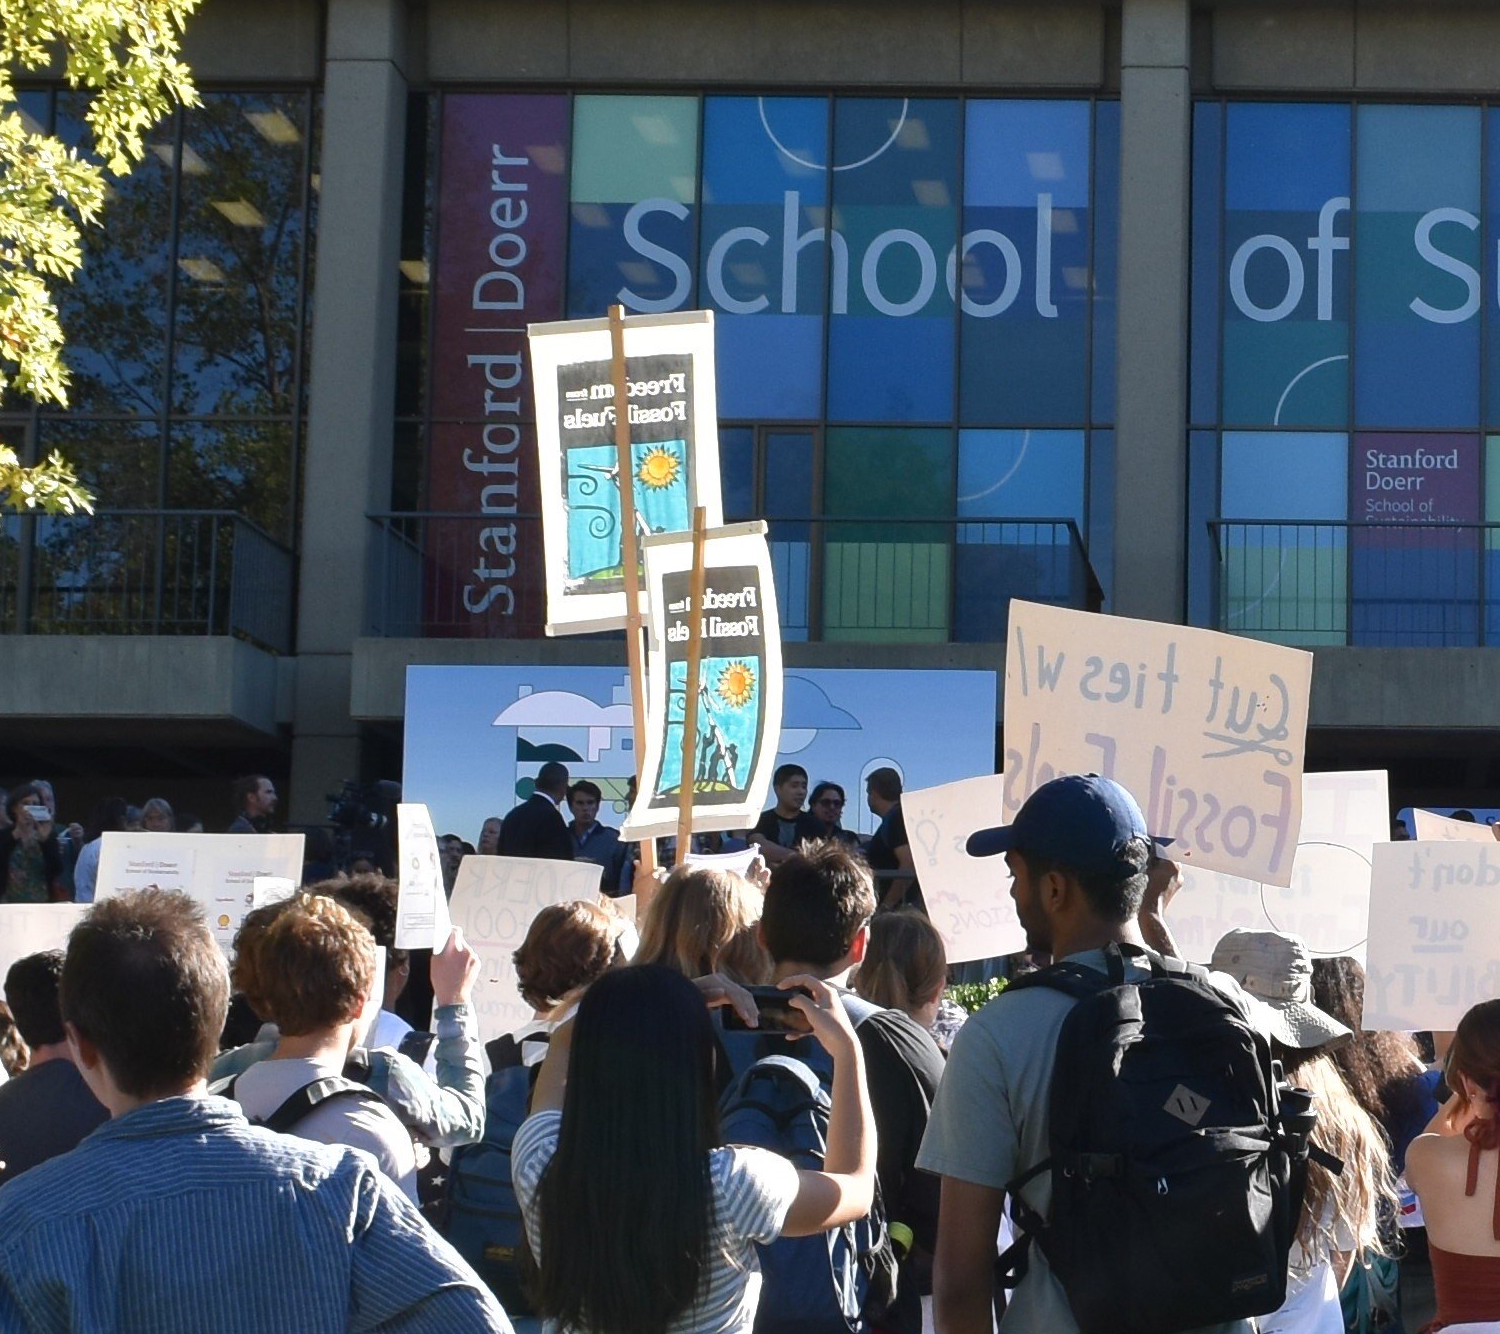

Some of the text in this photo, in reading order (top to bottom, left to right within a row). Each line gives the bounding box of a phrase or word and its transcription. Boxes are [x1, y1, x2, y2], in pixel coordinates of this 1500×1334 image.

[618, 190, 1059, 319] School
[1229, 196, 1350, 322] of
[463, 143, 529, 617] Stanford Doerr
[1365, 448, 1460, 469] Stanford
[1365, 471, 1425, 490] Doerr
[1365, 498, 1434, 513] School of
